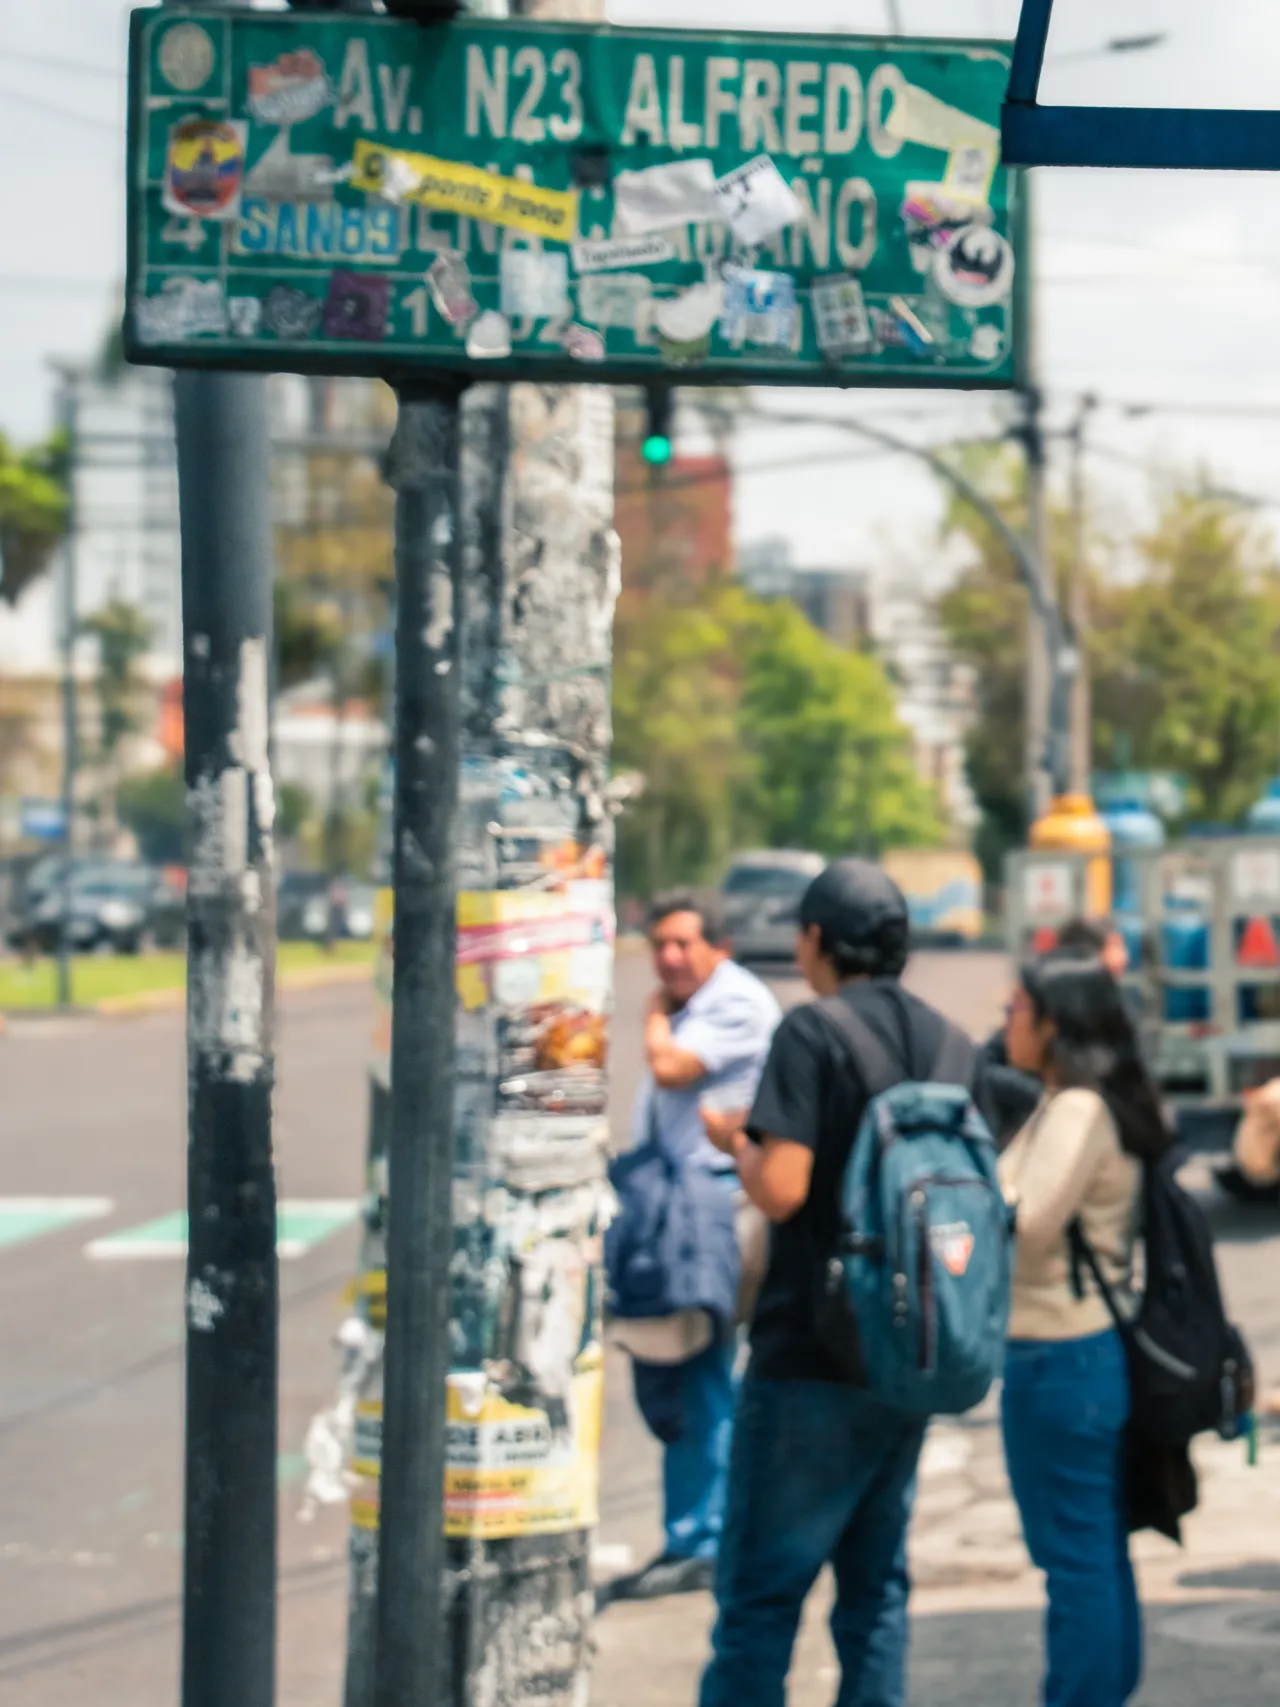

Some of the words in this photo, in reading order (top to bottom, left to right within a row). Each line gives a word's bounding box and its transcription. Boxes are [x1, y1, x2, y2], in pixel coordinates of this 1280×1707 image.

[332, 36, 423, 135] Av.
[464, 43, 583, 143] N23
[620, 52, 907, 159] ALFREDO
